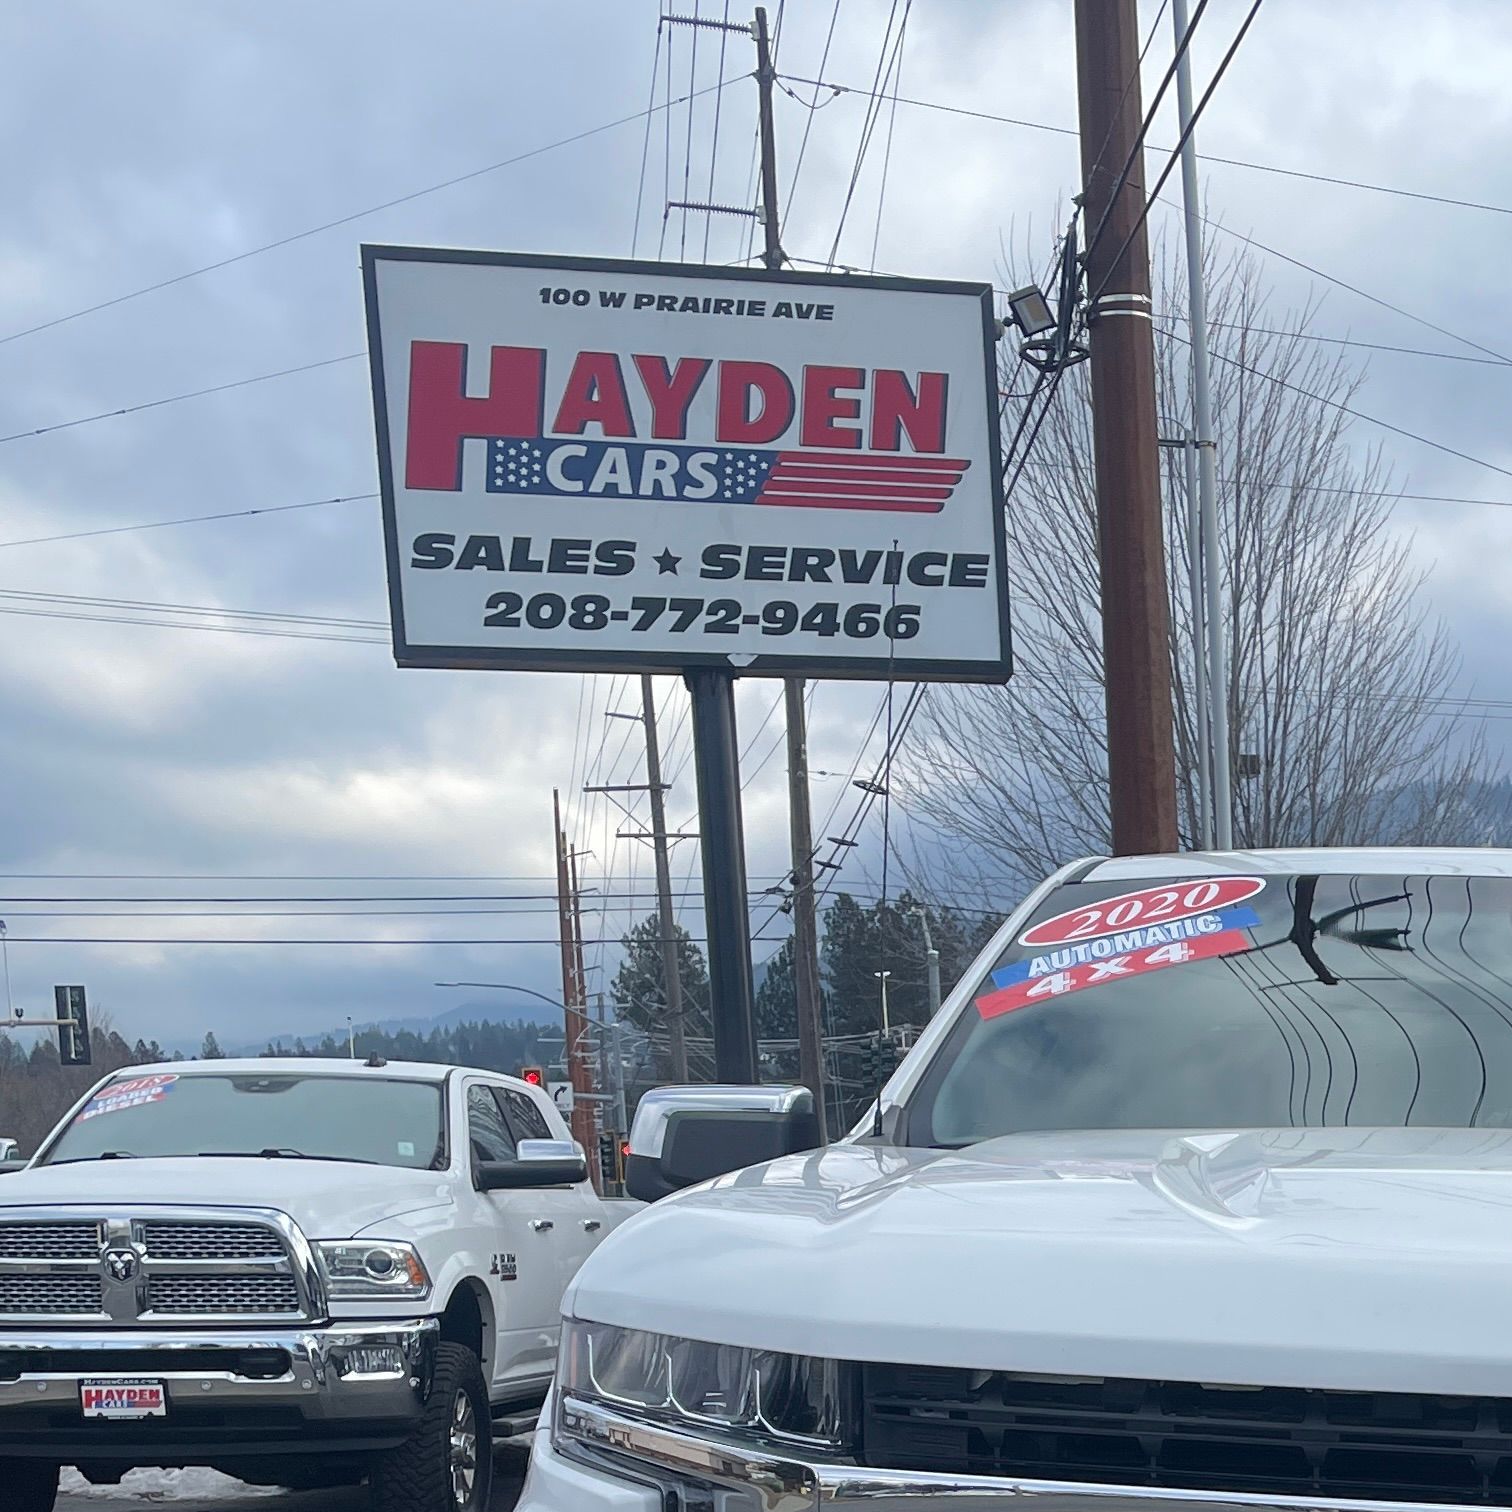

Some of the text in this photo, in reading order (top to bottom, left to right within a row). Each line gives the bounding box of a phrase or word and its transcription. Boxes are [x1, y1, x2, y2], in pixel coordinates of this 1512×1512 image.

[539, 287, 835, 321] 100 W PRAIRIE AVE
[405, 340, 949, 492] HAYDEN
[545, 444, 719, 499] CARS
[411, 533, 990, 588] SALES SERVICE
[484, 591, 921, 639] 208-772-9466
[1063, 882, 1220, 939] 2020
[1028, 914, 1222, 978] AUTOMATIC
[83, 1096, 157, 1119] DIESEL
[84, 1389, 160, 1408] HAYDEN
